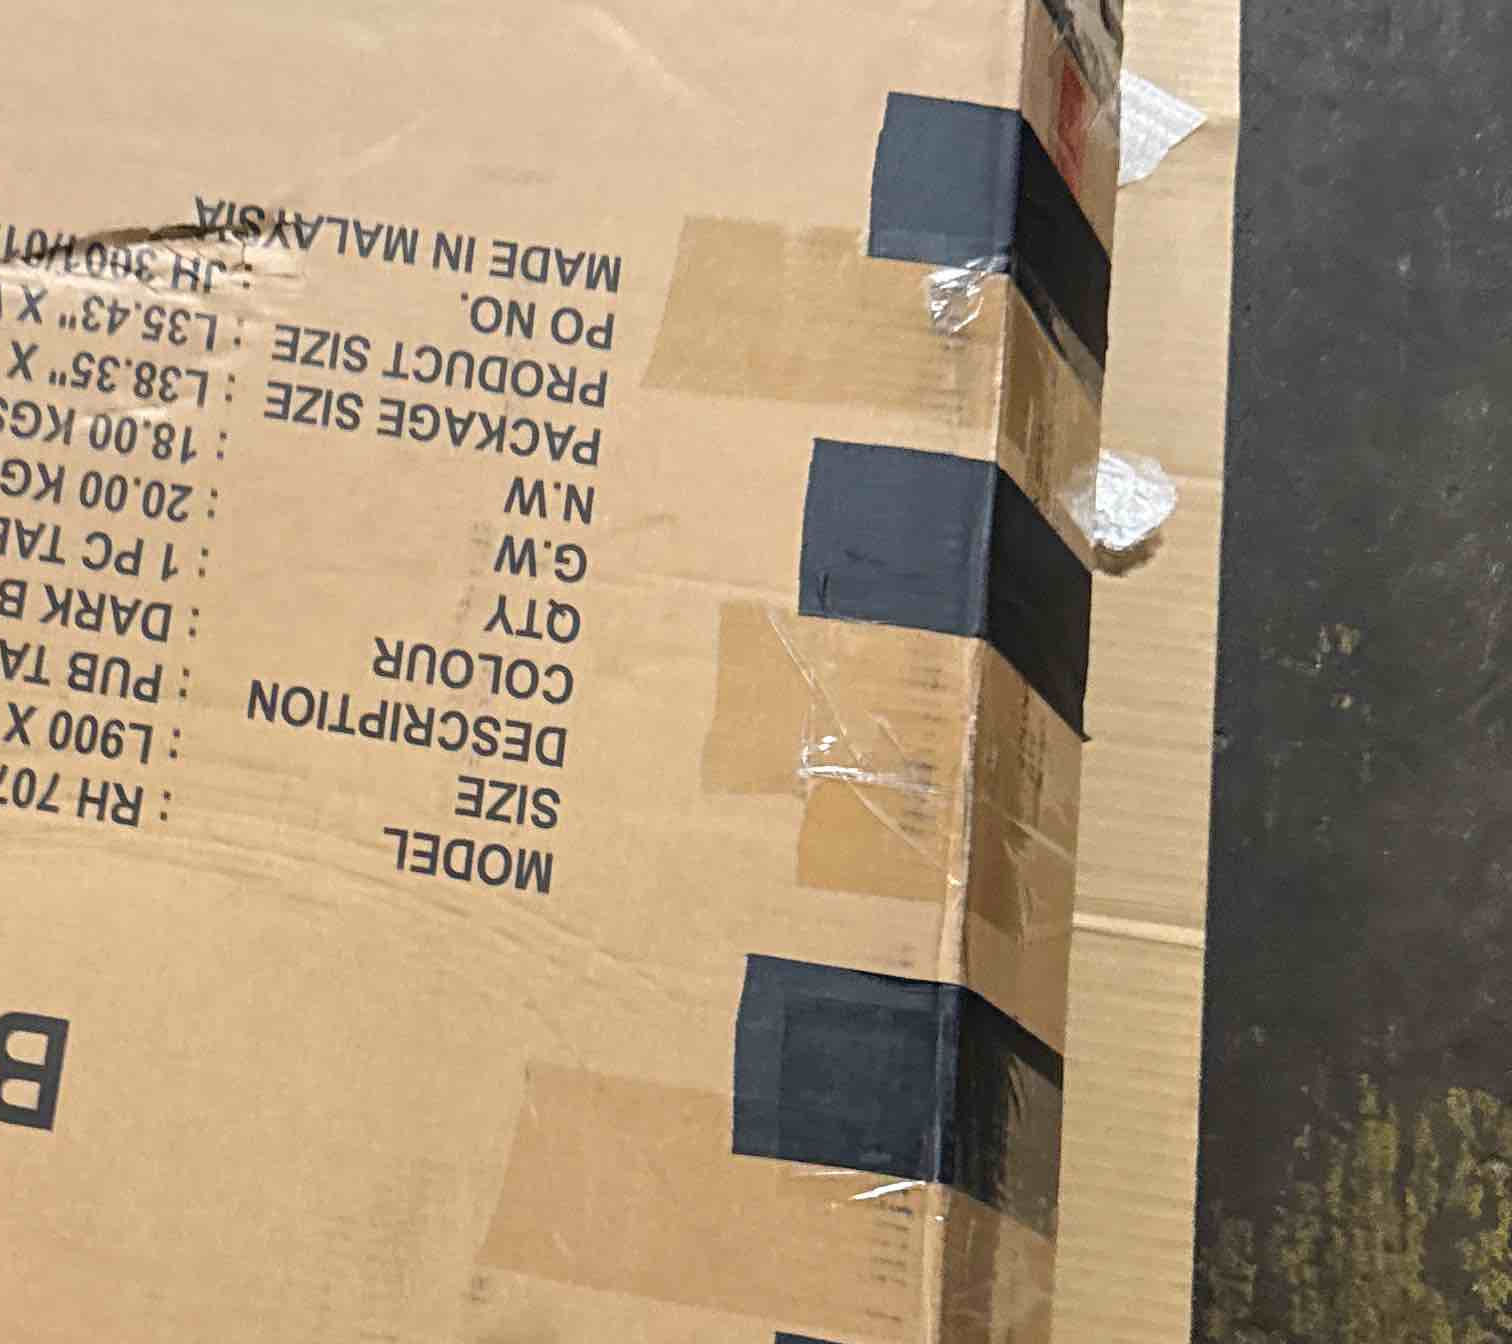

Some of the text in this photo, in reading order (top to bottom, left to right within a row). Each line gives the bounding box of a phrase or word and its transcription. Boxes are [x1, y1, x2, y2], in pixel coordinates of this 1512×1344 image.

[195, 196, 622, 294] MADE IN MALAYSIA
[171, 254, 227, 295] JH
[16, 284, 48, 326] X
[58, 295, 217, 353] L35.43"
[460, 292, 537, 340] NO.
[550, 306, 615, 351] PO
[6, 339, 39, 382] X
[271, 323, 372, 374] SIZE
[381, 340, 608, 409] PRODUCT
[48, 350, 209, 409] L38.35"
[263, 379, 364, 433] SIZE
[88, 412, 198, 465] 18.00
[376, 396, 601, 467] PACKAGE
[79, 469, 194, 523] 20.00
[503, 475, 595, 526] N.W
[81, 530, 145, 577] PC
[160, 542, 179, 583] 1
[493, 533, 588, 584] G.W
[38, 583, 174, 644] DARK
[482, 593, 581, 645] QTY
[66, 650, 164, 704] PUB
[372, 636, 574, 705] COLOUR
[2, 701, 38, 748] X
[48, 709, 154, 765] L900
[247, 679, 569, 769] DESCRIPTION
[75, 776, 144, 829] RH
[454, 774, 561, 830] SIZE
[383, 826, 554, 895] MODEL
